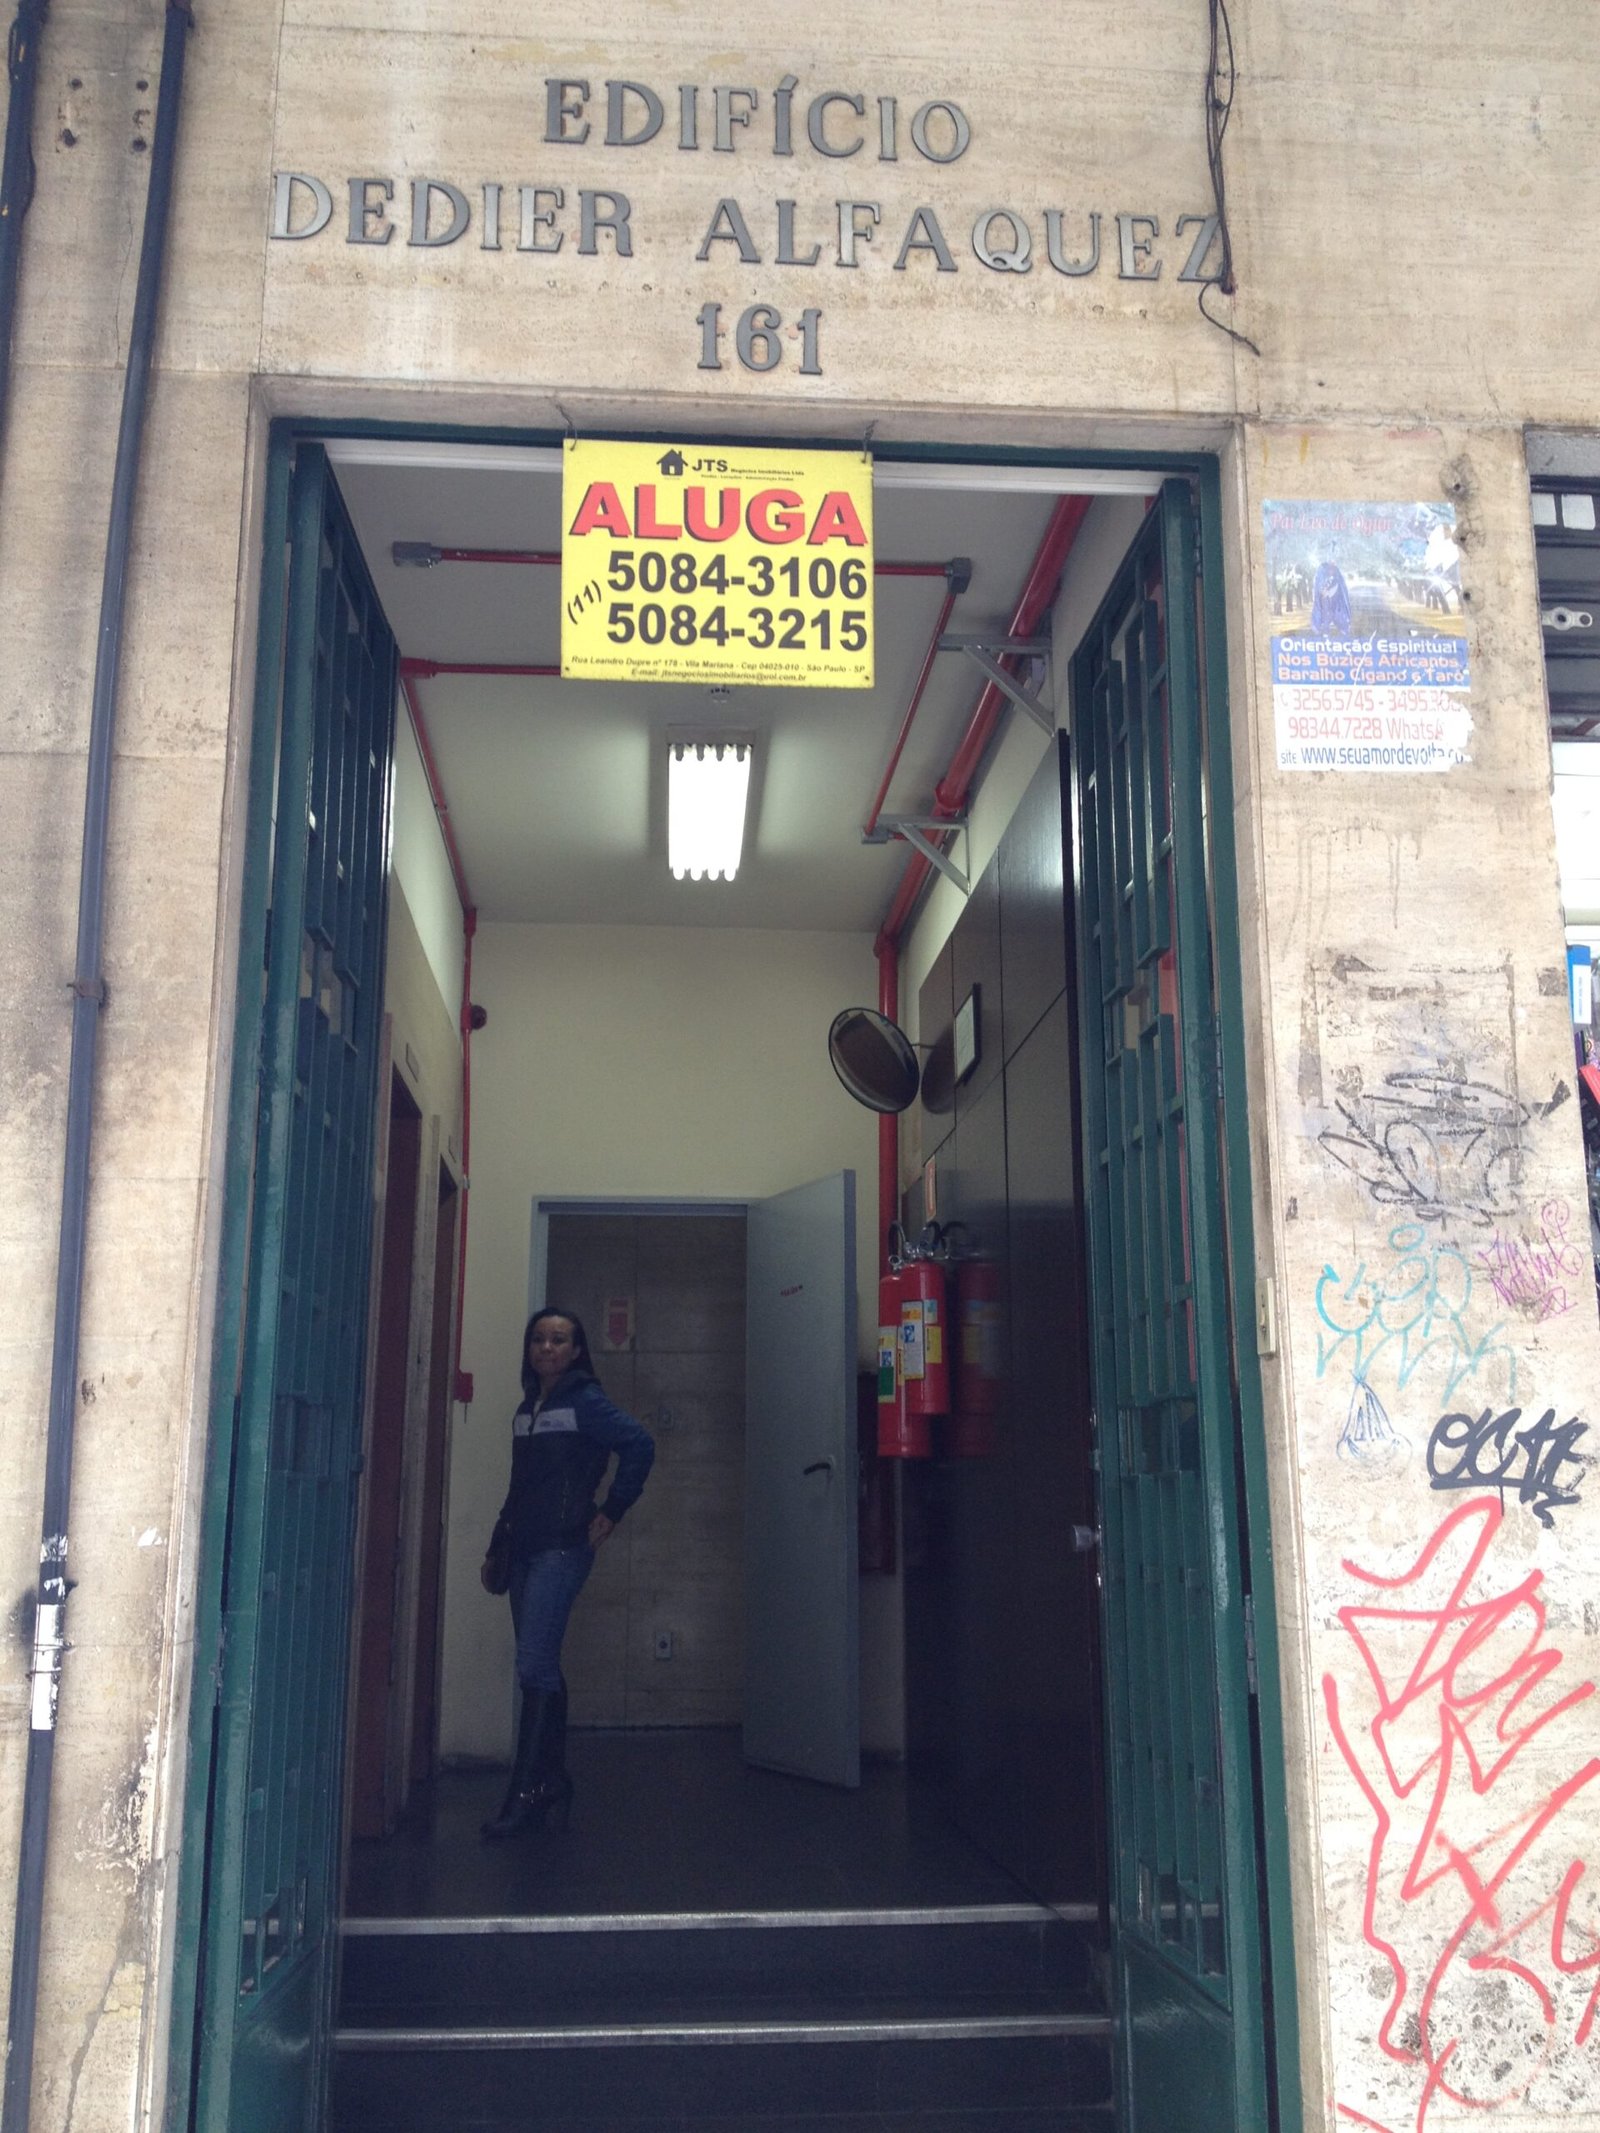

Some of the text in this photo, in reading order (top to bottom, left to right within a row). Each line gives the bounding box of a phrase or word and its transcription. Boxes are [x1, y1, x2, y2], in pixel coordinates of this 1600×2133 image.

[543, 75, 971, 164] EDIFÍCIO
[269, 171, 1227, 283] DEDIER ALFAQUEZ
[695, 301, 823, 376] 161
[692, 459, 728, 472] JTS
[568, 481, 869, 546] ALUGA
[607, 550, 867, 600] 5084-3106
[567, 580, 602, 625] (11)
[606, 602, 867, 652] 5084-3215
[1280, 637, 1457, 656] Orientação Espiritual
[571, 655, 588, 664] Rua
[590, 656, 624, 665] Leandro
[685, 660, 700, 668] Vila
[702, 660, 734, 669] Mariana
[807, 663, 822, 672] São
[824, 664, 847, 673] Paulo
[854, 665, 866, 673] SP
[1278, 652, 1311, 666] Nos
[1278, 667, 1345, 681] Baralho
[1350, 668, 1408, 684] Cigano
[1293, 688, 1375, 711] 3256.5745
[1288, 716, 1382, 740] 98344.7228
[1280, 749, 1297, 764] site
